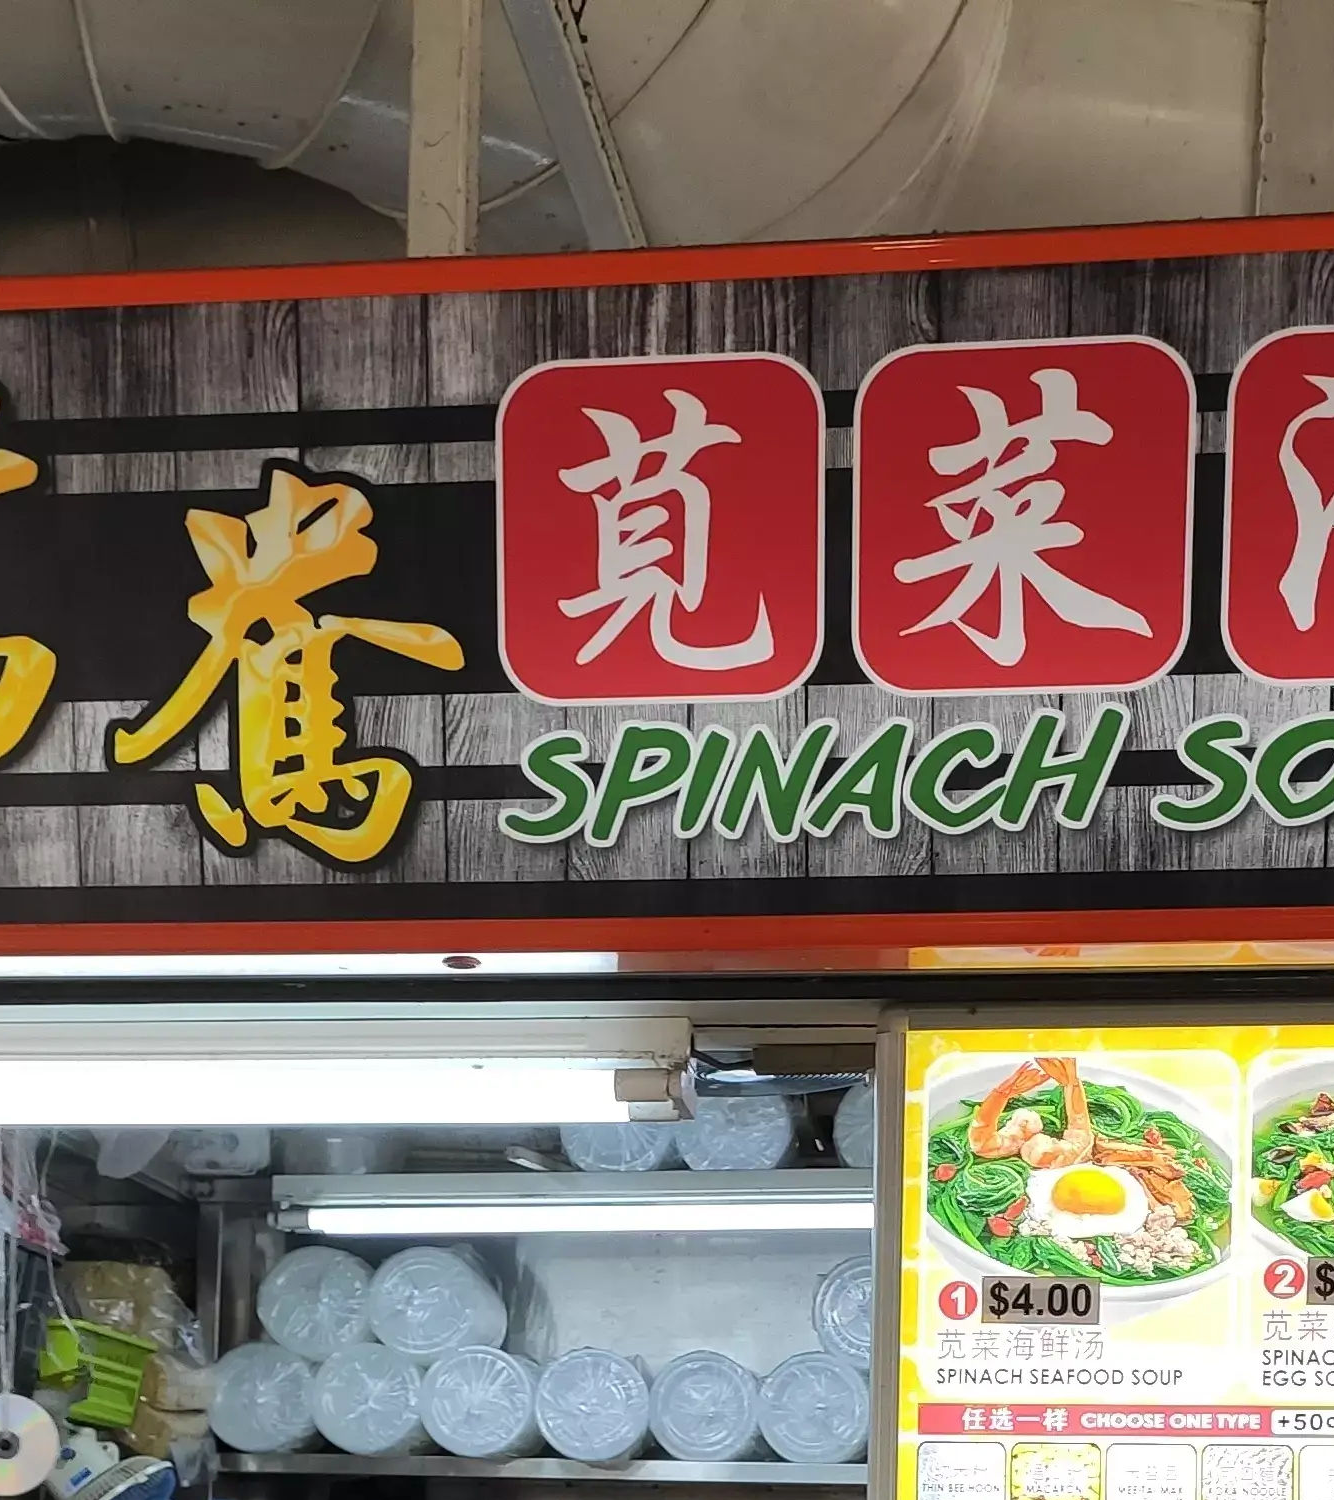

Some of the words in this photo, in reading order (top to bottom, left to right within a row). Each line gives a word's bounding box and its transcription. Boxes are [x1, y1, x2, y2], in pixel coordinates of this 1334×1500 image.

[501, 702, 1128, 844] SPINACH
[988, 1280, 1093, 1320] $4.00
[937, 1328, 1105, 1361] 苋菜海鲜汤
[936, 1368, 1023, 1386] SPINACH
[1029, 1368, 1125, 1386] SEAFOOD
[1131, 1369, 1183, 1386] SOUP
[1262, 1370, 1307, 1387] EGG
[961, 1406, 1069, 1432] 任选一样
[1080, 1411, 1166, 1430] CHOOSE
[1168, 1412, 1213, 1430] ONE
[1216, 1412, 1262, 1431] TYPE
